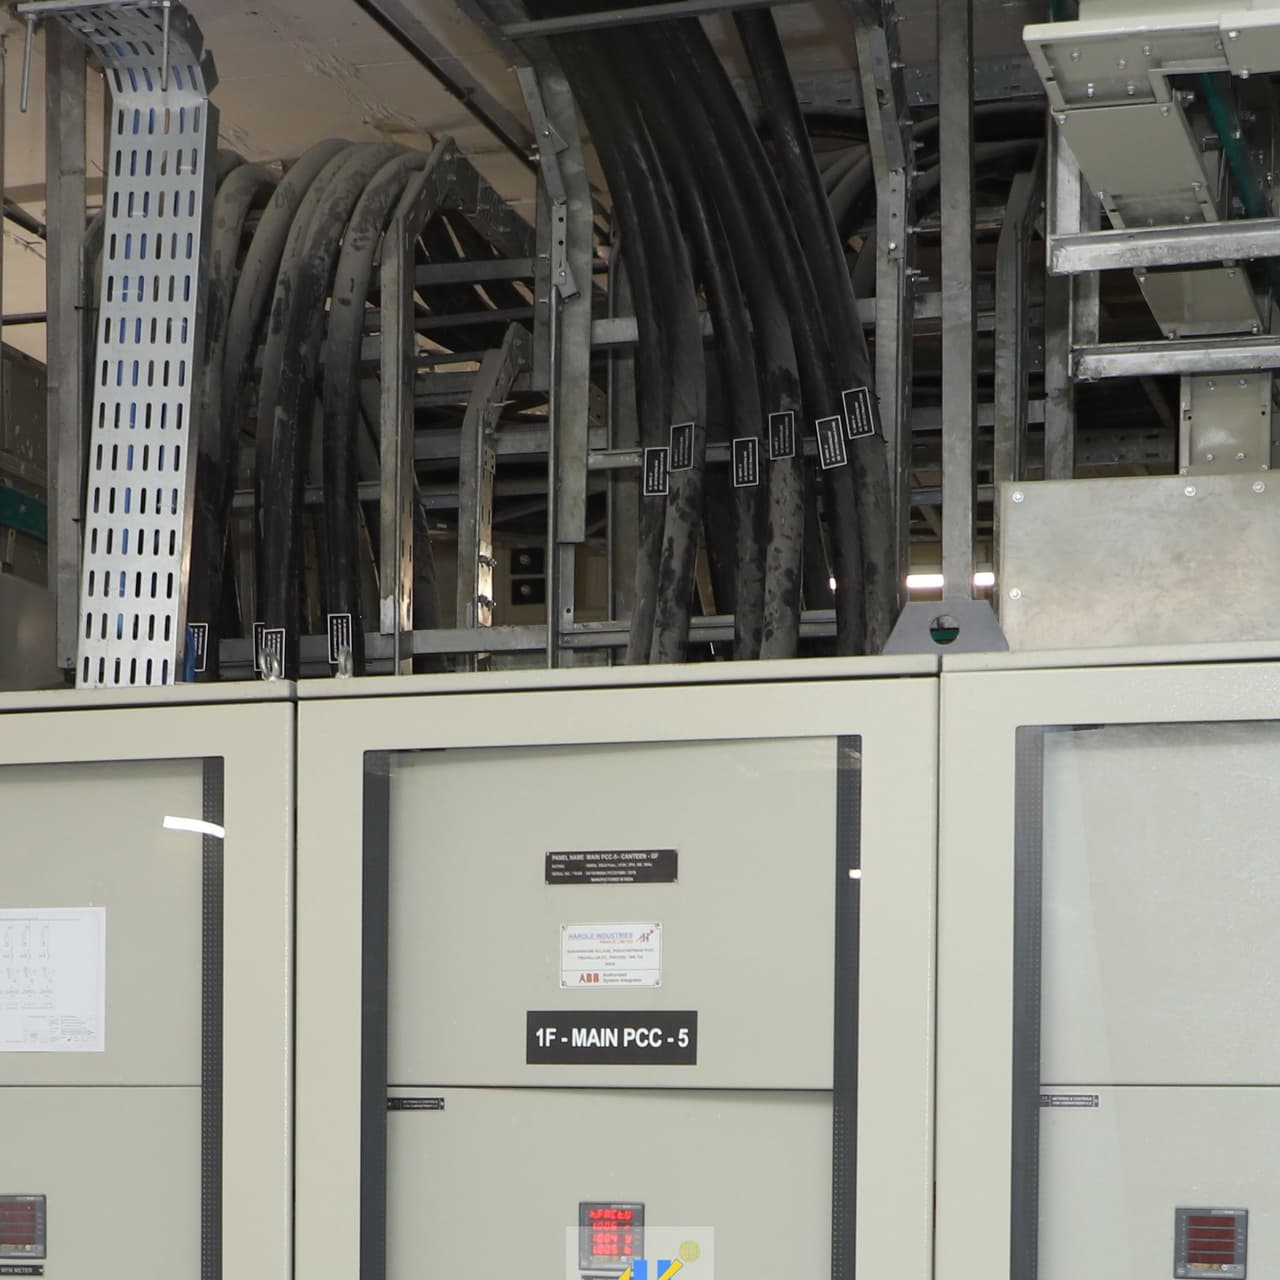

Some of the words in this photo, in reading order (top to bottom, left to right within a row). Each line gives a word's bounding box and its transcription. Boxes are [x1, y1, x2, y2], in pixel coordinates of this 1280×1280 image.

[579, 973, 599, 983] ABB
[535, 1028, 556, 1047] 1F
[572, 1028, 618, 1047] MAIN
[623, 1028, 662, 1047] PCC
[678, 1028, 688, 1048] 5
